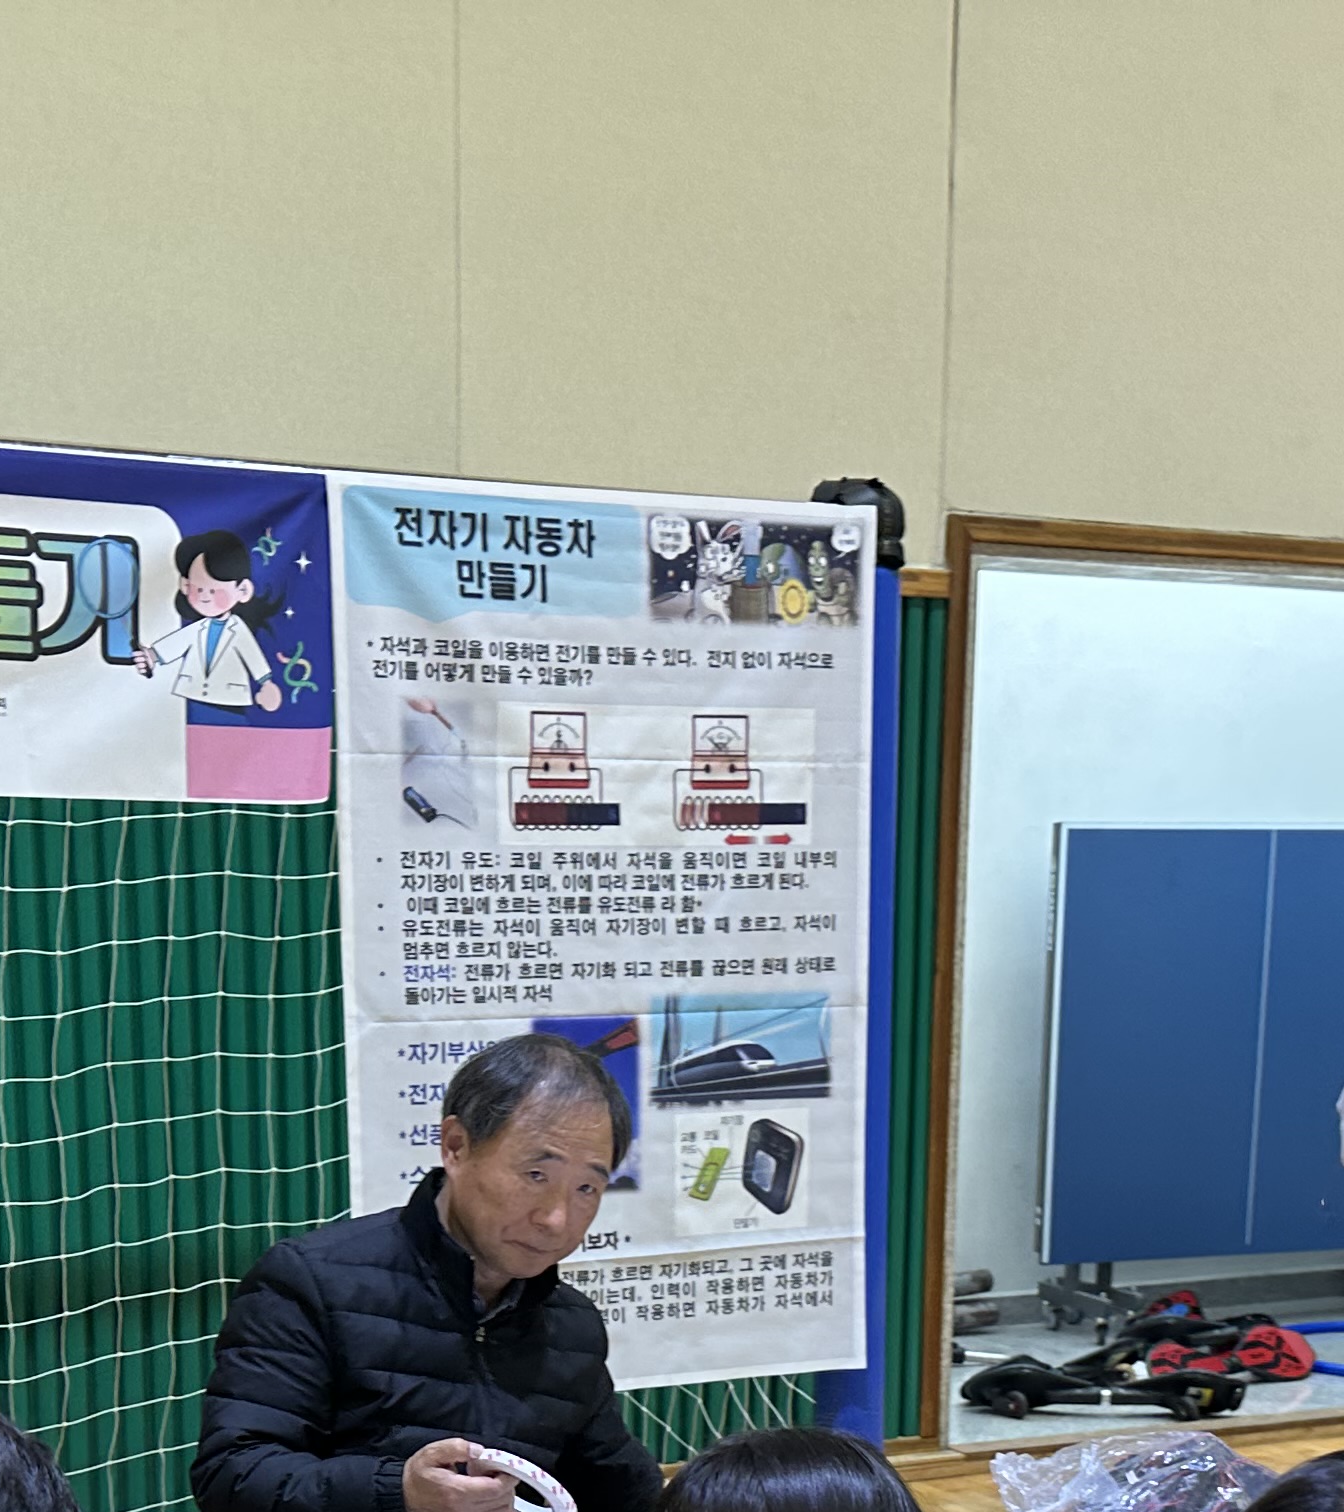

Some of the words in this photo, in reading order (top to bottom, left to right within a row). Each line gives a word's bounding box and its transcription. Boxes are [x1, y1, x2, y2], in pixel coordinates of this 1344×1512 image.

[393, 506, 489, 552] 전자기
[503, 514, 596, 558] 자동차
[456, 559, 550, 603] 만들기
[379, 636, 428, 657] 자석과
[433, 638, 484, 659] 코일을
[488, 641, 550, 662] 이용하면
[555, 643, 601, 664] 전기를
[607, 646, 637, 667] 만들
[642, 648, 658, 667] 수
[741, 650, 773, 669] 없이
[777, 651, 834, 670] 자석으로
[372, 659, 419, 680] 전기를
[425, 662, 475, 683] 어떻게
[480, 664, 513, 684] 만들
[517, 665, 533, 685] 수
[537, 666, 594, 687] 있을까?
[400, 851, 451, 869] 전자기
[509, 852, 543, 870] 코일
[552, 852, 618, 870] 주위에서
[626, 852, 673, 870] 자석을
[682, 852, 748, 870] 움직이면
[757, 852, 787, 869] 코일
[794, 850, 838, 868] 내부의
[400, 874, 464, 892] 자기장이
[469, 874, 516, 892] 변하게
[562, 874, 593, 892] 이에
[598, 874, 627, 892] 따라
[631, 874, 676, 892] 코일에
[680, 874, 725, 891] 전류가
[730, 873, 775, 890] 흐르게
[406, 896, 439, 915] 이때
[444, 896, 491, 914] 코일에
[495, 896, 541, 914] 흐르는
[547, 896, 592, 915] 전류를
[597, 895, 656, 913] 유도전류
[661, 896, 676, 913] 라
[401, 919, 484, 937] 유도전류는
[493, 918, 541, 937] 자석이
[550, 918, 597, 937] 움직여
[606, 917, 666, 936] 자기장이
[675, 917, 705, 934] 변할
[715, 916, 731, 934] 때
[793, 914, 836, 932] 자석이
[403, 941, 450, 960] 멈추면
[455, 941, 502, 959] 흐르지
[464, 963, 511, 982] 전류가
[518, 963, 563, 980] 흐르면
[571, 961, 617, 980] 자기화
[624, 961, 653, 978] 되고
[660, 959, 704, 978] 전류를
[794, 956, 836, 974] 상태로
[404, 986, 467, 1005] 돌아가는
[472, 985, 518, 1004] 일시적
[522, 984, 553, 1003] 자석
[610, 1264, 654, 1282] 흐르면
[739, 1257, 754, 1272] 그
[759, 1254, 787, 1271] 곳에
[792, 1250, 834, 1268] 자석을
[650, 1280, 697, 1300] 인력이
[706, 1275, 766, 1296] 작용하면
[774, 1269, 834, 1291] 자동차가
[636, 1300, 696, 1320] 작용하면
[706, 1295, 766, 1315] 자동차가
[774, 1290, 834, 1309] 자석에서
